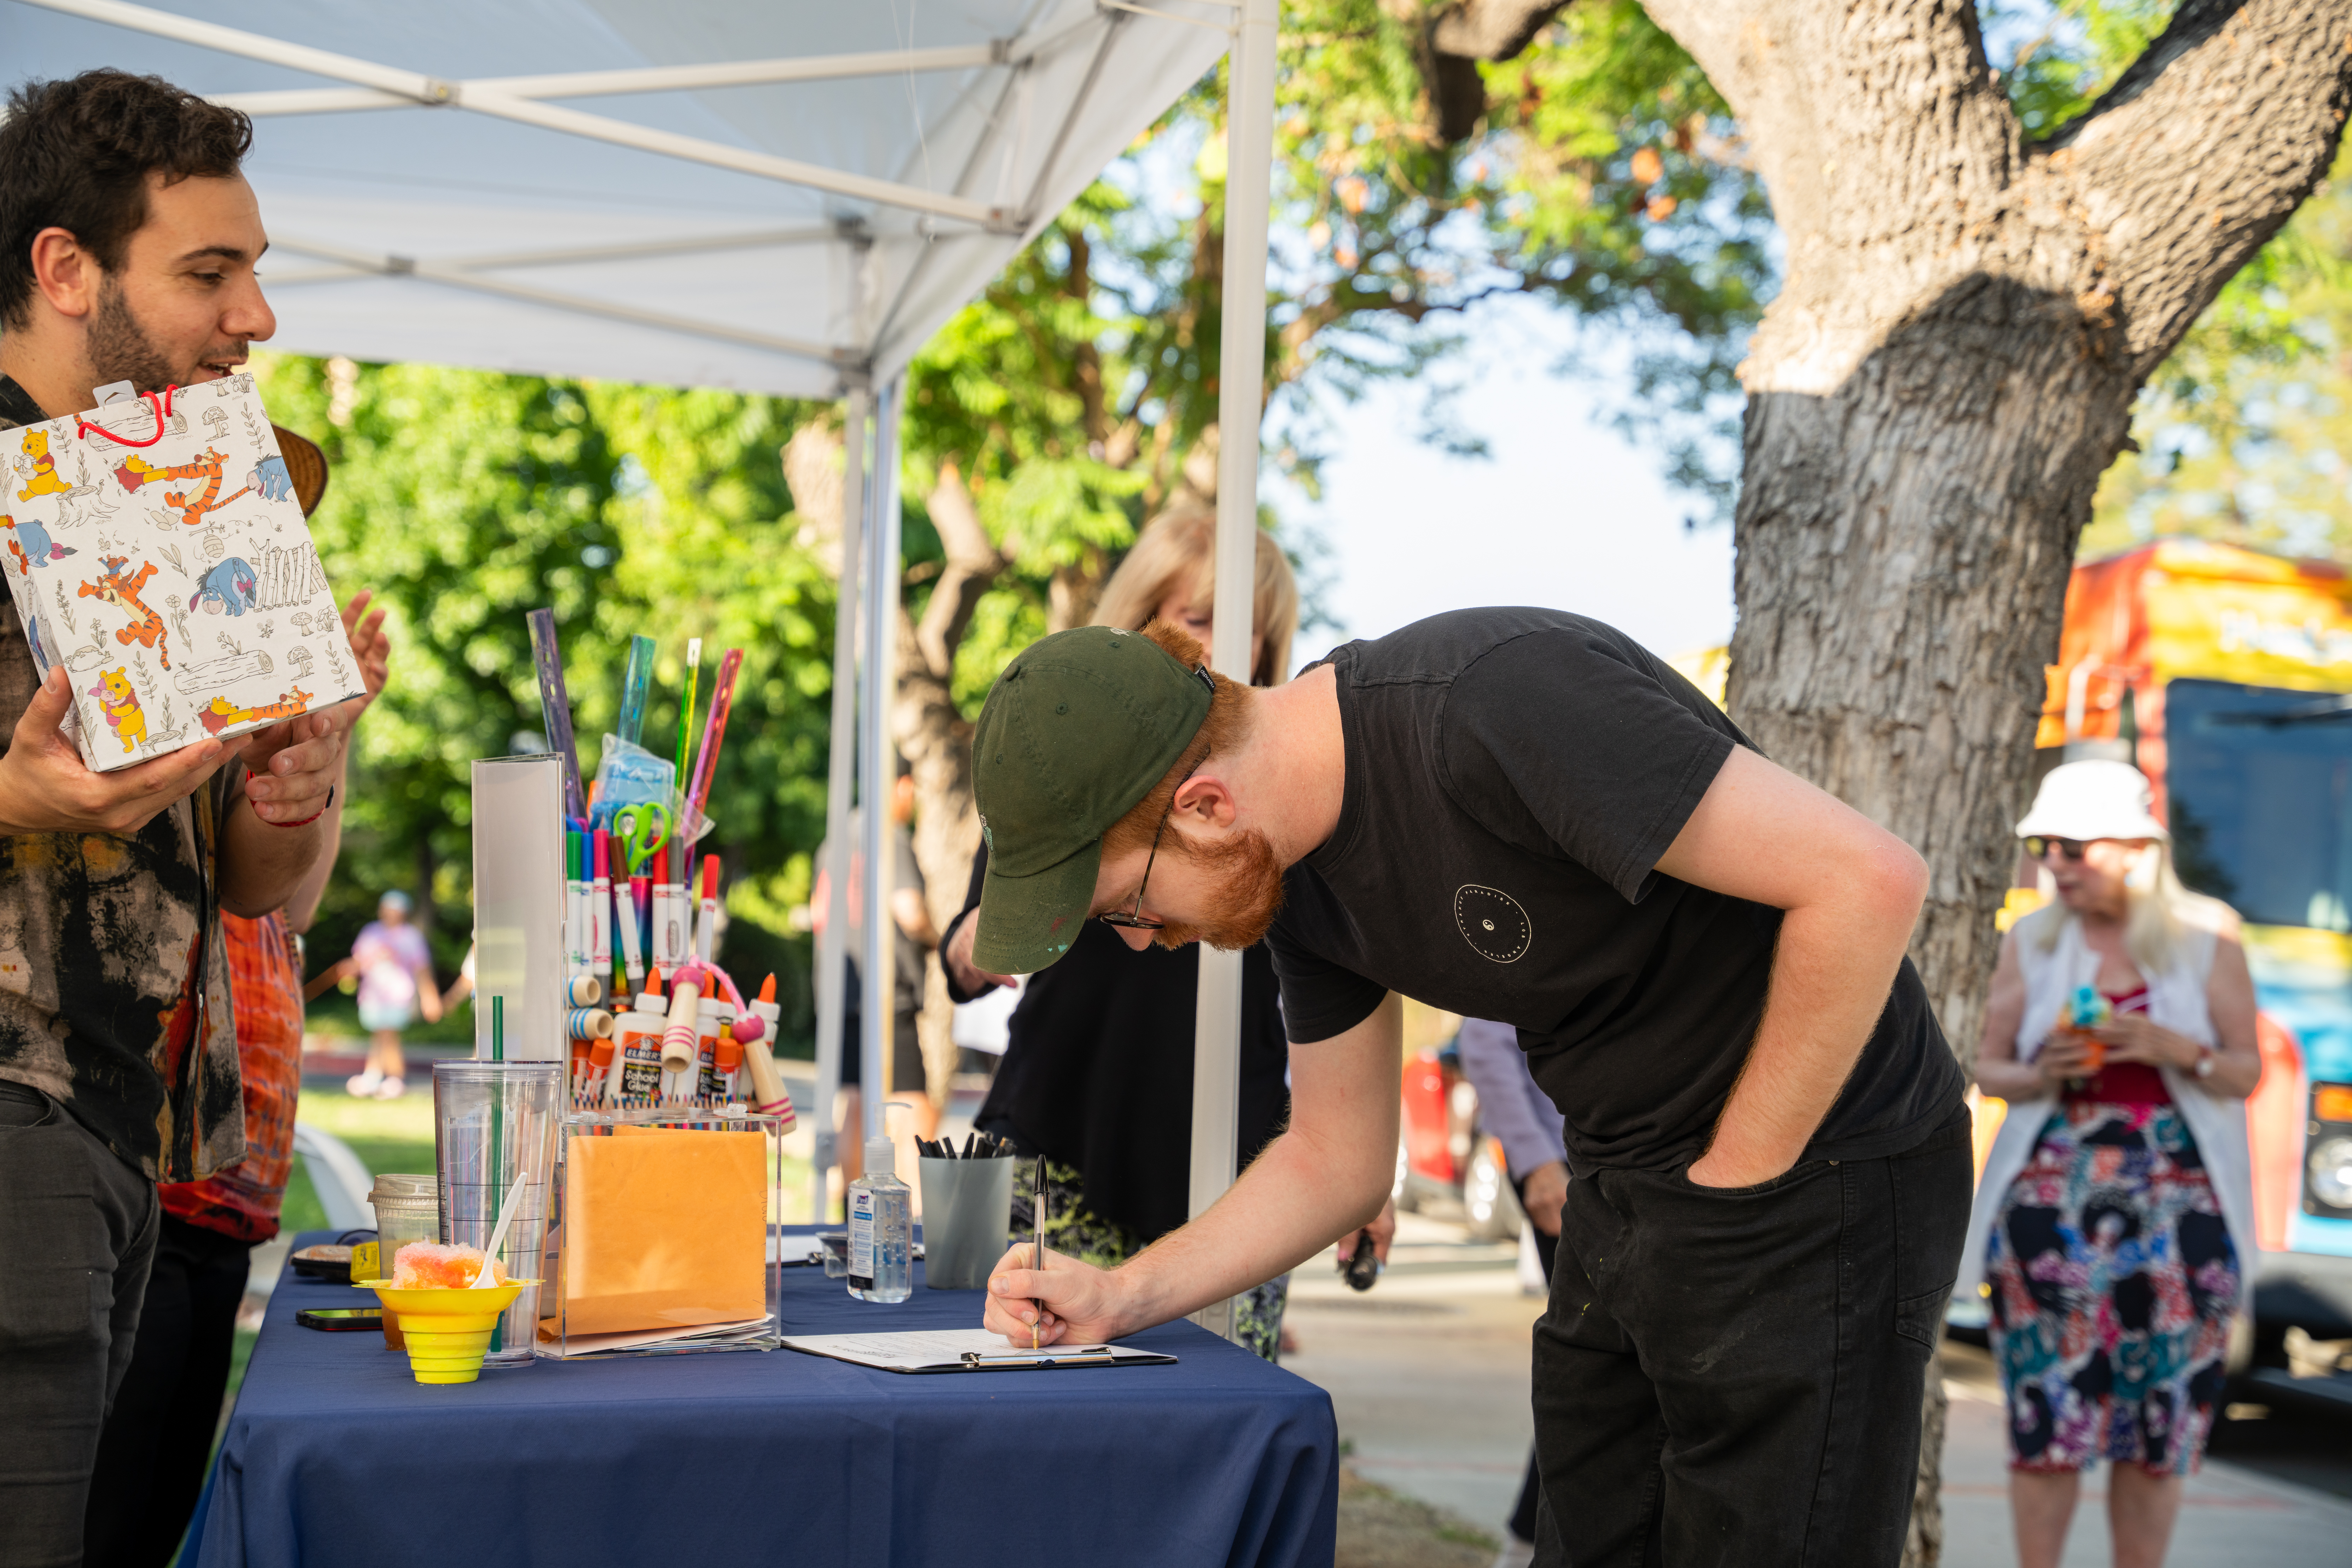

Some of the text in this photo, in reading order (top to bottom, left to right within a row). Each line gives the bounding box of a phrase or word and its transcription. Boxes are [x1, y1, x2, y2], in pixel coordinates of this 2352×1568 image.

[1200, 670, 1214, 688] ripndip
[1465, 890, 1510, 905] PARADISE
[1459, 896, 1470, 937] STRANGE
[1484, 945, 1521, 958] ANGELES
[625, 1069, 660, 1084] School
[628, 1080, 650, 1093] Glue
